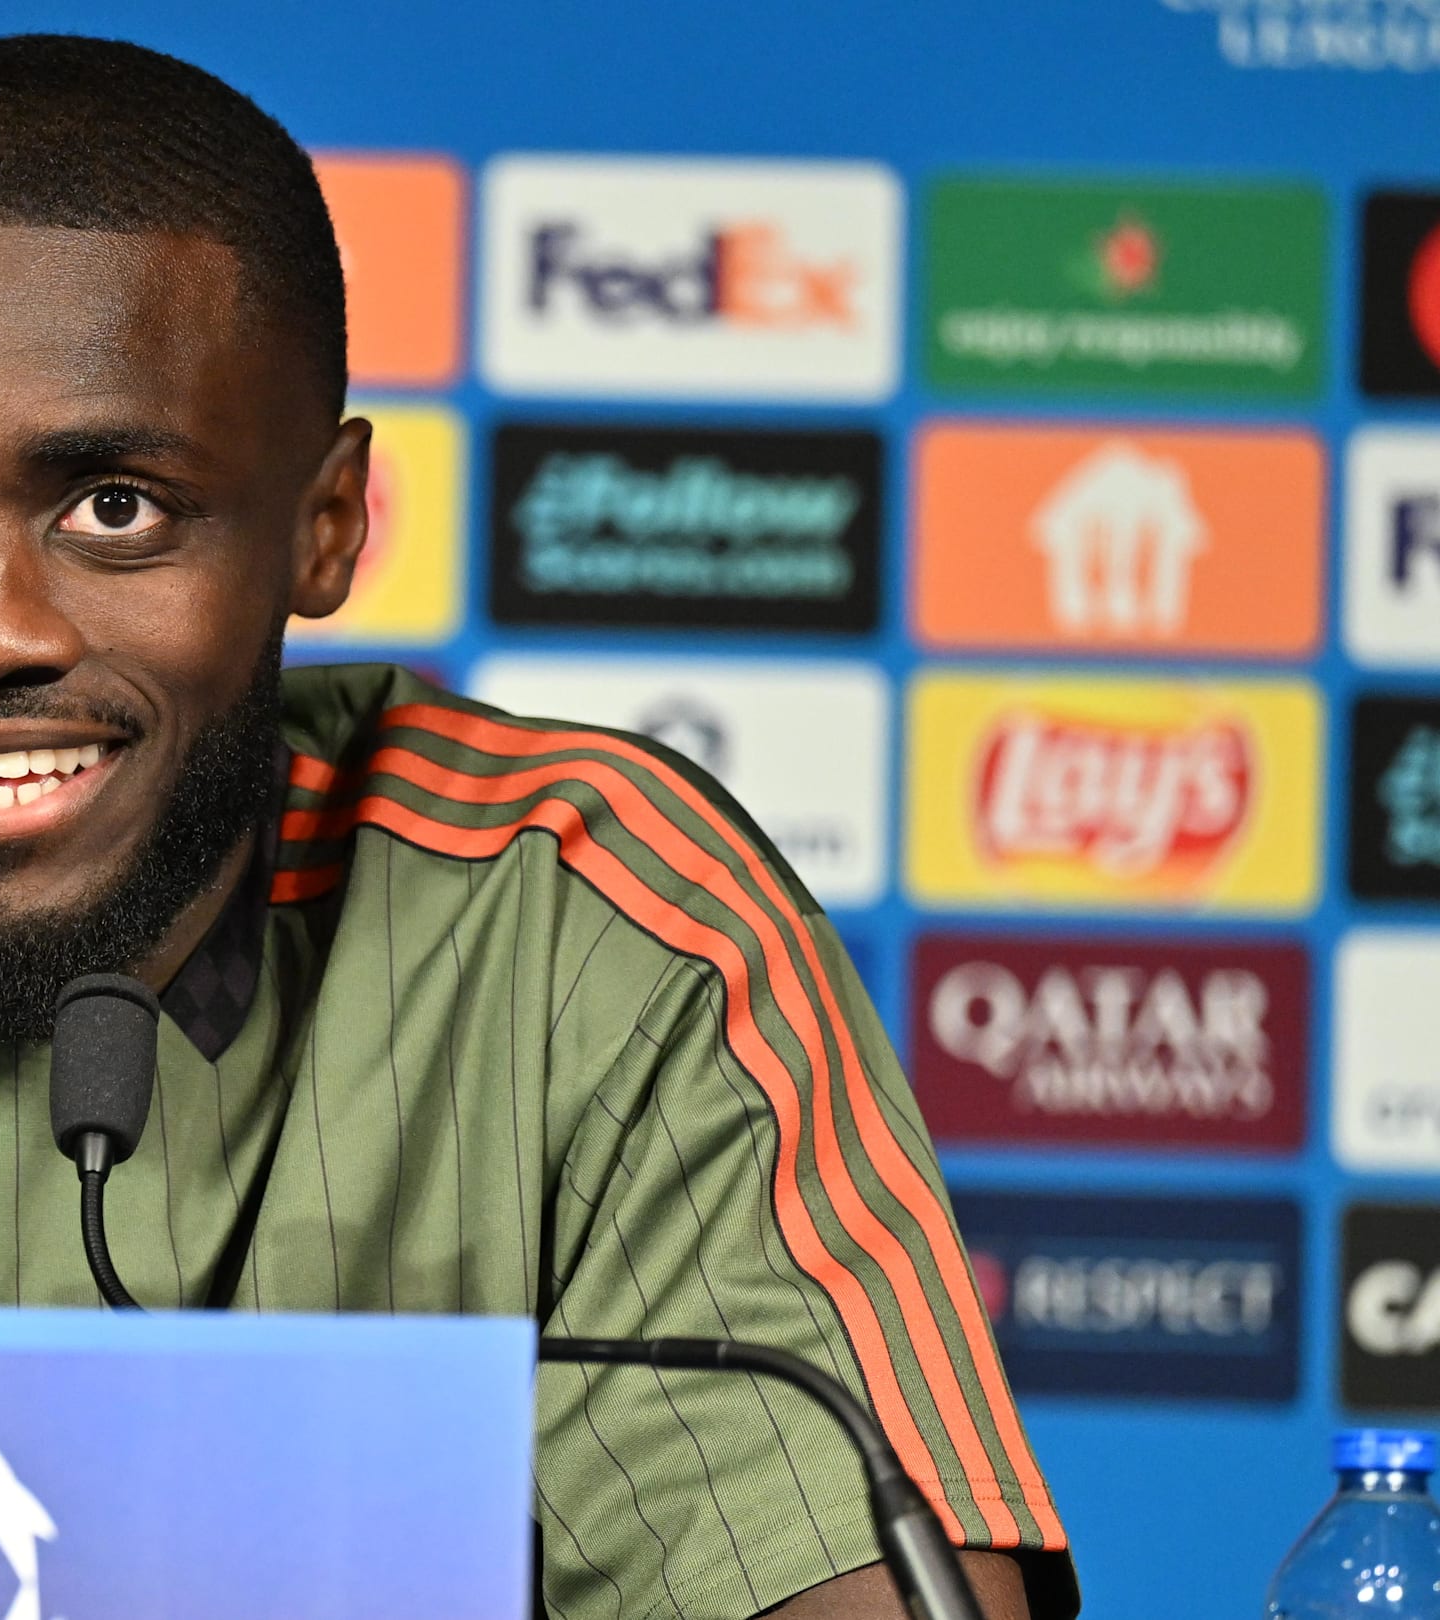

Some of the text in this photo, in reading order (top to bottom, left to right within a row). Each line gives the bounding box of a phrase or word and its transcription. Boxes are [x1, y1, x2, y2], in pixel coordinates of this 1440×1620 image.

[1220, 12, 1440, 62] LEAGU
[525, 217, 865, 329] FedEx
[936, 970, 1265, 1071] QATAR
[1016, 1056, 1270, 1111] AIRWAYS
[1018, 1260, 1278, 1330] RESPECT
